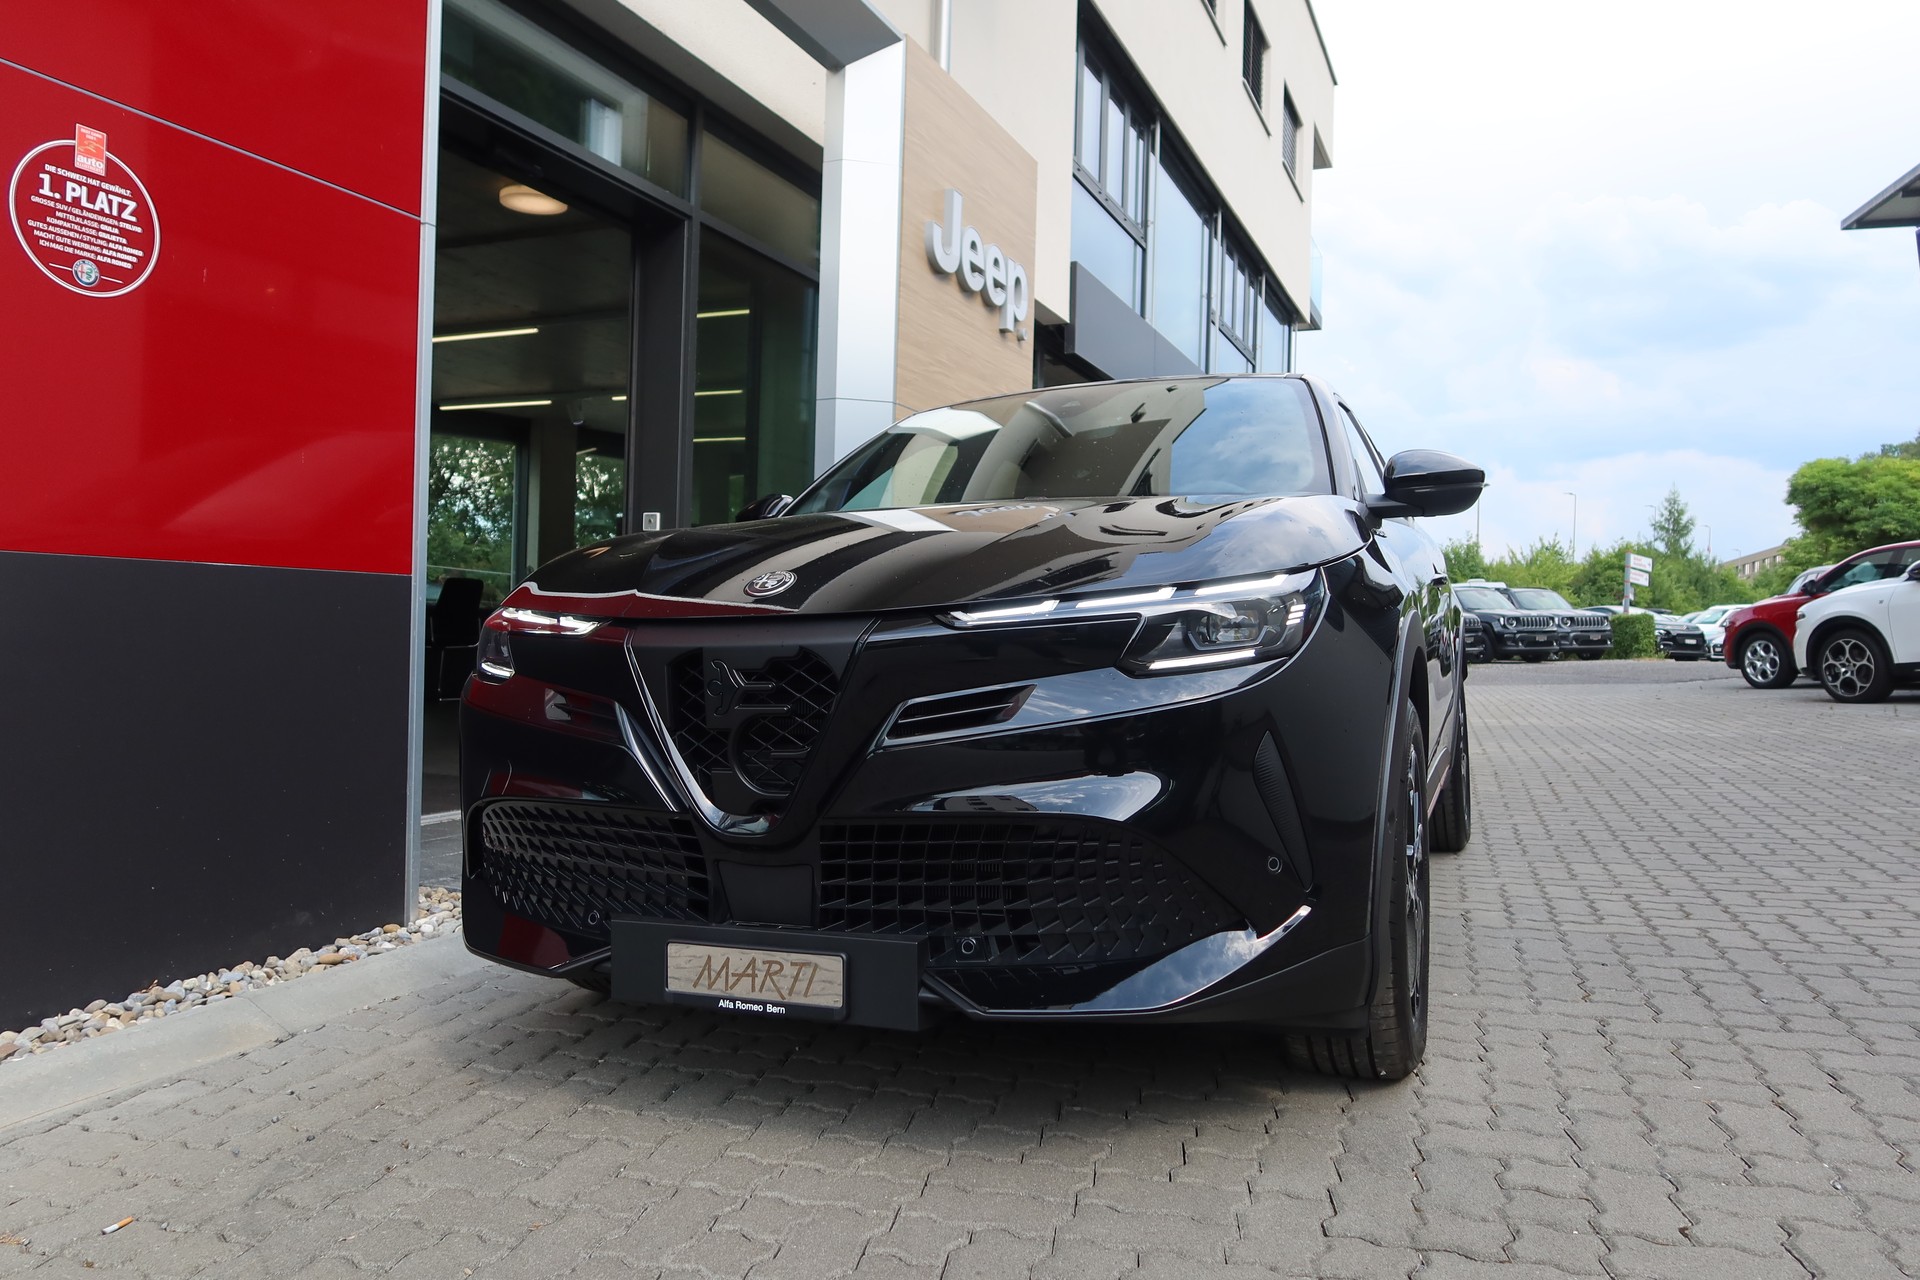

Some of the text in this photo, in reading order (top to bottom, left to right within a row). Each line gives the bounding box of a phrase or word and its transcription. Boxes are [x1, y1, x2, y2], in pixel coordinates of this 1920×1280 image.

[44, 164, 57, 174] DIE
[56, 167, 87, 183] SCHWEIZ
[87, 177, 101, 187] HAT
[77, 154, 104, 169] auto
[38, 173, 138, 223] 1. PLATZ
[31, 195, 55, 208] GROSSE
[55, 203, 68, 211] SUV
[119, 221, 143, 234] STELVIO
[46, 216, 98, 236] KOMPAKTKLASSE:
[56, 211, 119, 234] MITTELKLASSE: GIULIA
[27, 219, 48, 230] GUTES
[48, 225, 80, 239] AUSSEHEN
[108, 242, 123, 252] ALFA
[123, 246, 144, 257] ROMEO
[33, 230, 55, 240] MACHT
[55, 236, 71, 245] GUTE
[102, 248, 116, 258] ALFA
[116, 252, 138, 263] ROMEO
[39, 239, 50, 248] ICH
[50, 242, 64, 251] MAG
[64, 245, 74, 254] DIE
[96, 255, 111, 264] ALFA
[111, 258, 133, 269] ROMEO
[925, 188, 1029, 333] Jeep
[692, 954, 818, 1000] MARTI
[718, 999, 786, 1014] Alfa Romeo Bern
